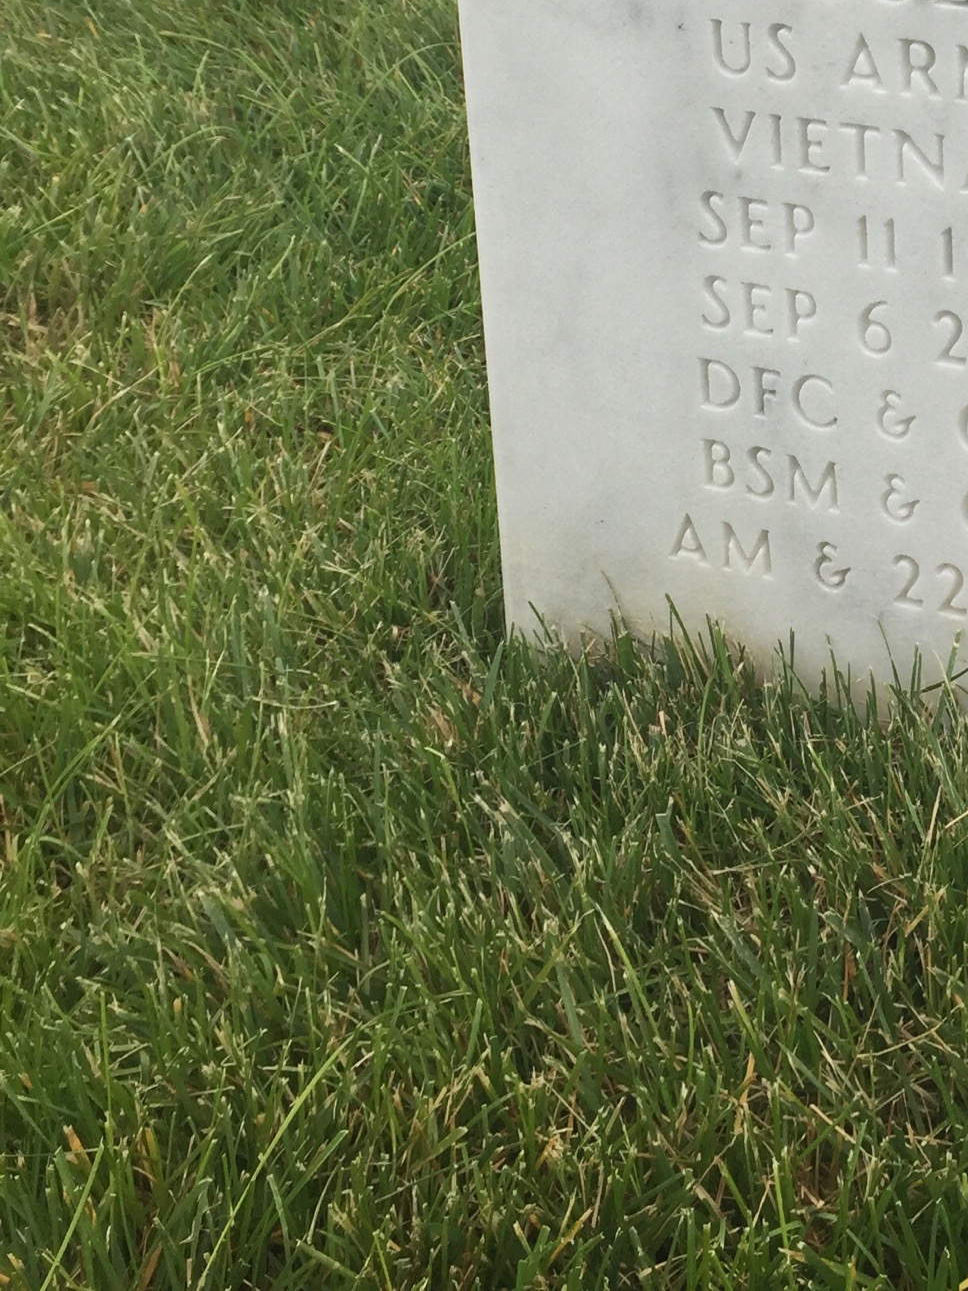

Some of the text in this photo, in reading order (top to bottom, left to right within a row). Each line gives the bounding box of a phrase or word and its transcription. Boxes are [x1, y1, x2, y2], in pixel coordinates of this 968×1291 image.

[709, 18, 797, 83] US
[698, 189, 816, 259] SEP
[855, 214, 898, 272] 11
[701, 274, 817, 342] SEP
[855, 300, 893, 358] 6
[697, 356, 838, 431] DFC
[876, 389, 917, 441] &
[701, 438, 841, 513] BSM
[880, 473, 920, 525] &
[667, 513, 774, 580] AM
[811, 541, 852, 593] &
[892, 554, 968, 619] 22
